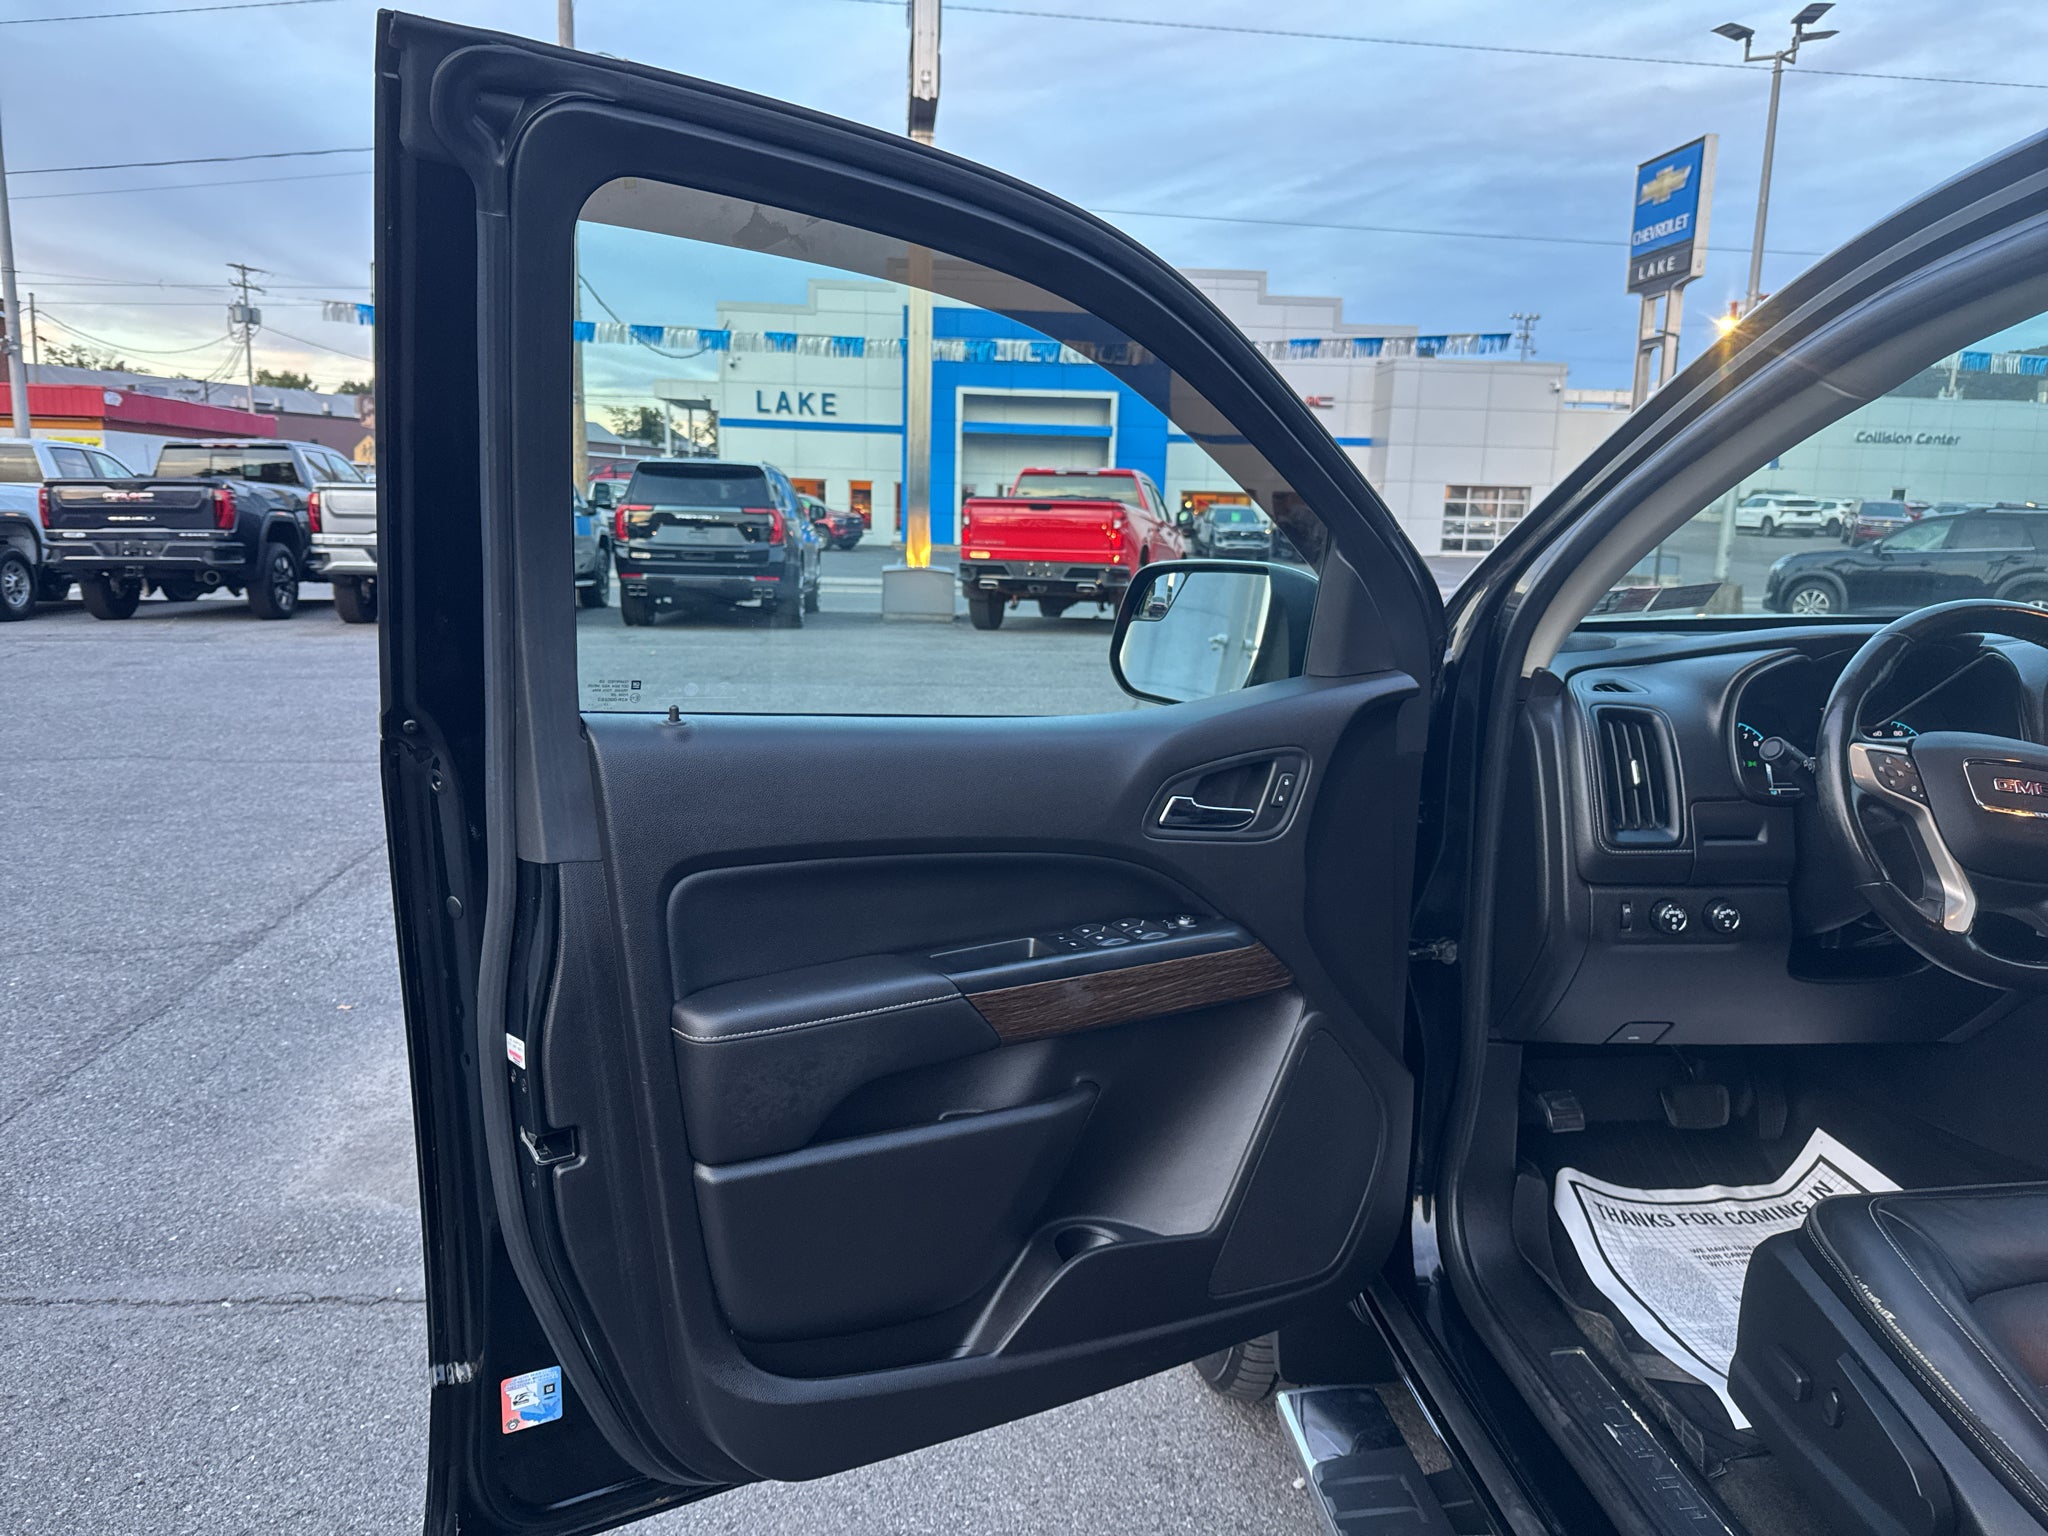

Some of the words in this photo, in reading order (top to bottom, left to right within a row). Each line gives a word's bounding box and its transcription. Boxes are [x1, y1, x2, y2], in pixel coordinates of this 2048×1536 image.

[1632, 213, 1690, 246] CHEVROLET
[1638, 256, 1677, 281] LAKE
[756, 390, 837, 416] LAKE
[1856, 431, 1912, 444] Collision
[1915, 433, 1961, 445] Center
[1593, 1201, 1675, 1229] THANKS
[1676, 1212, 1724, 1226] FOR
[1724, 1200, 1810, 1226] COMING
[1807, 1180, 1834, 1201] IN
